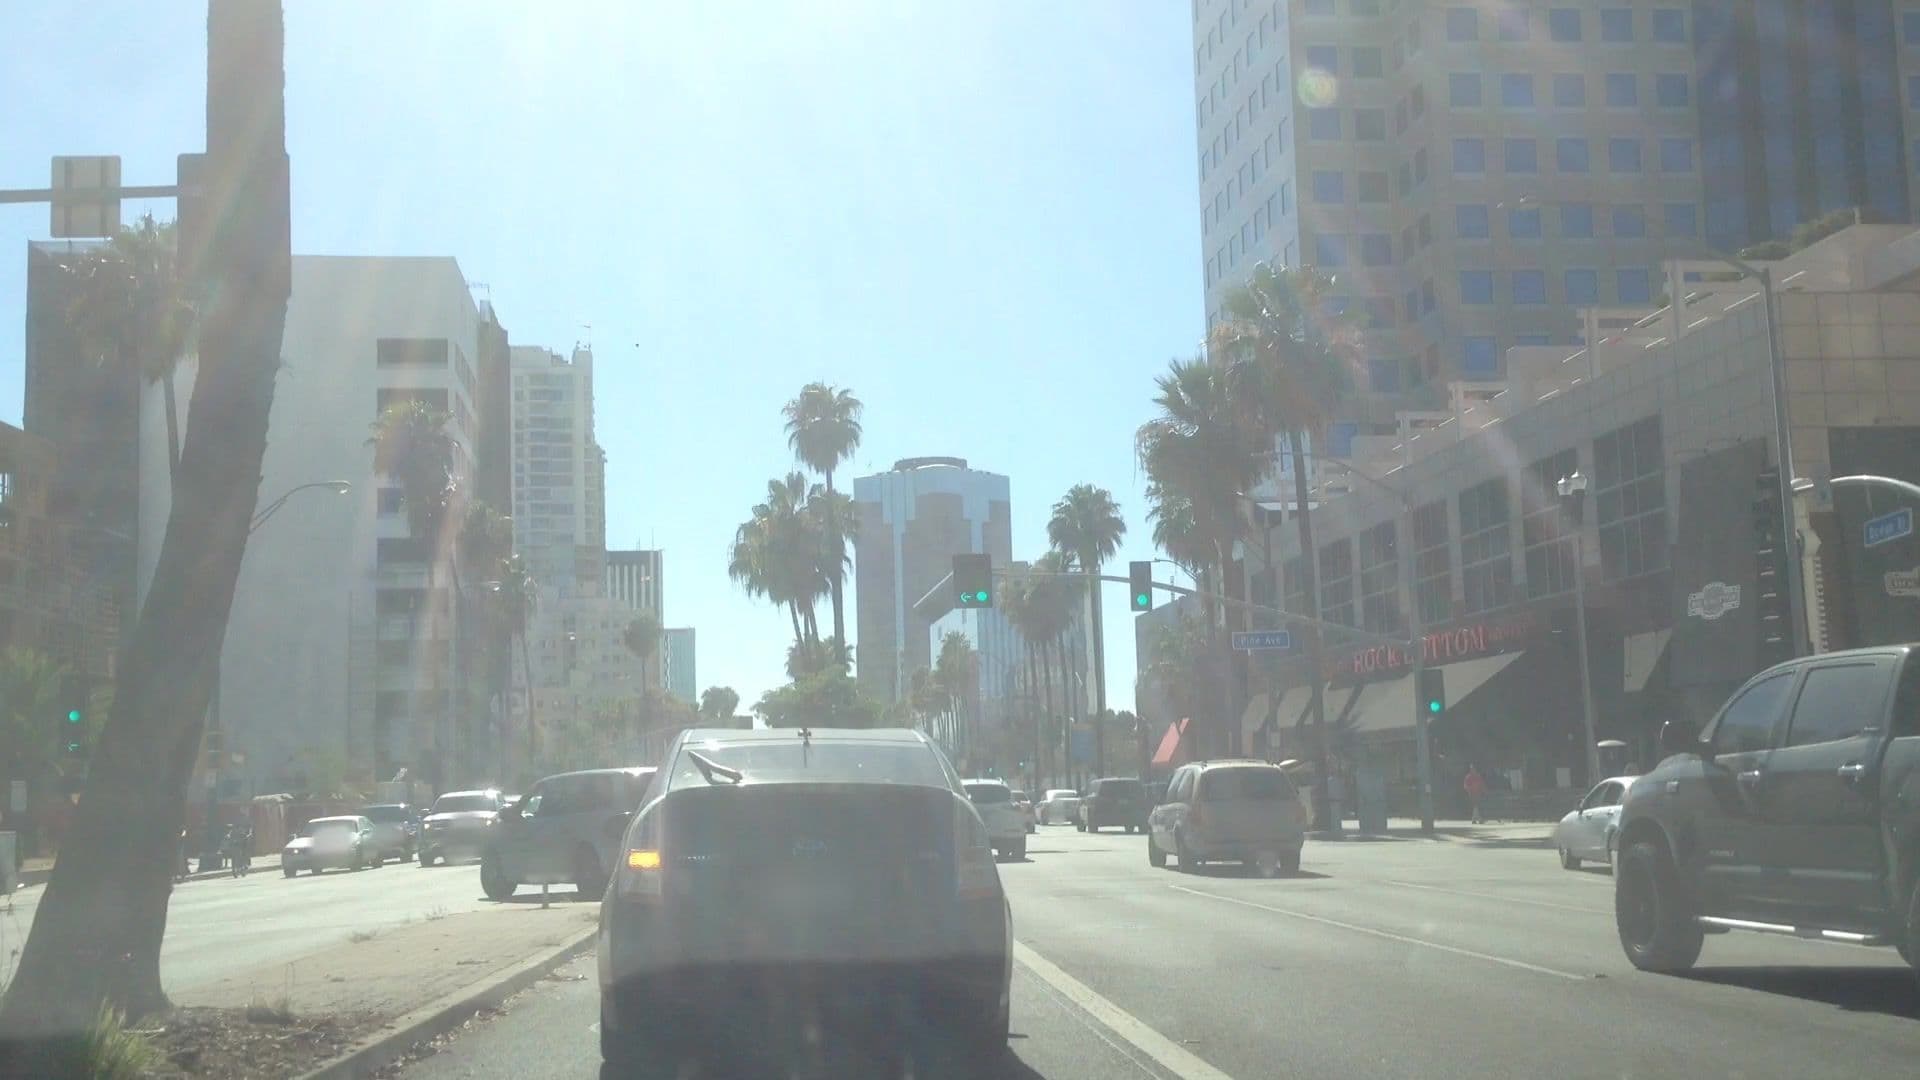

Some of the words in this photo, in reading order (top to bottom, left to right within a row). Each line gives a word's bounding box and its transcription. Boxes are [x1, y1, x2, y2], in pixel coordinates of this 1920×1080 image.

[1240, 634, 1261, 646] Pine
[1265, 634, 1281, 646] Ave
[1353, 644, 1401, 672] ROCK
